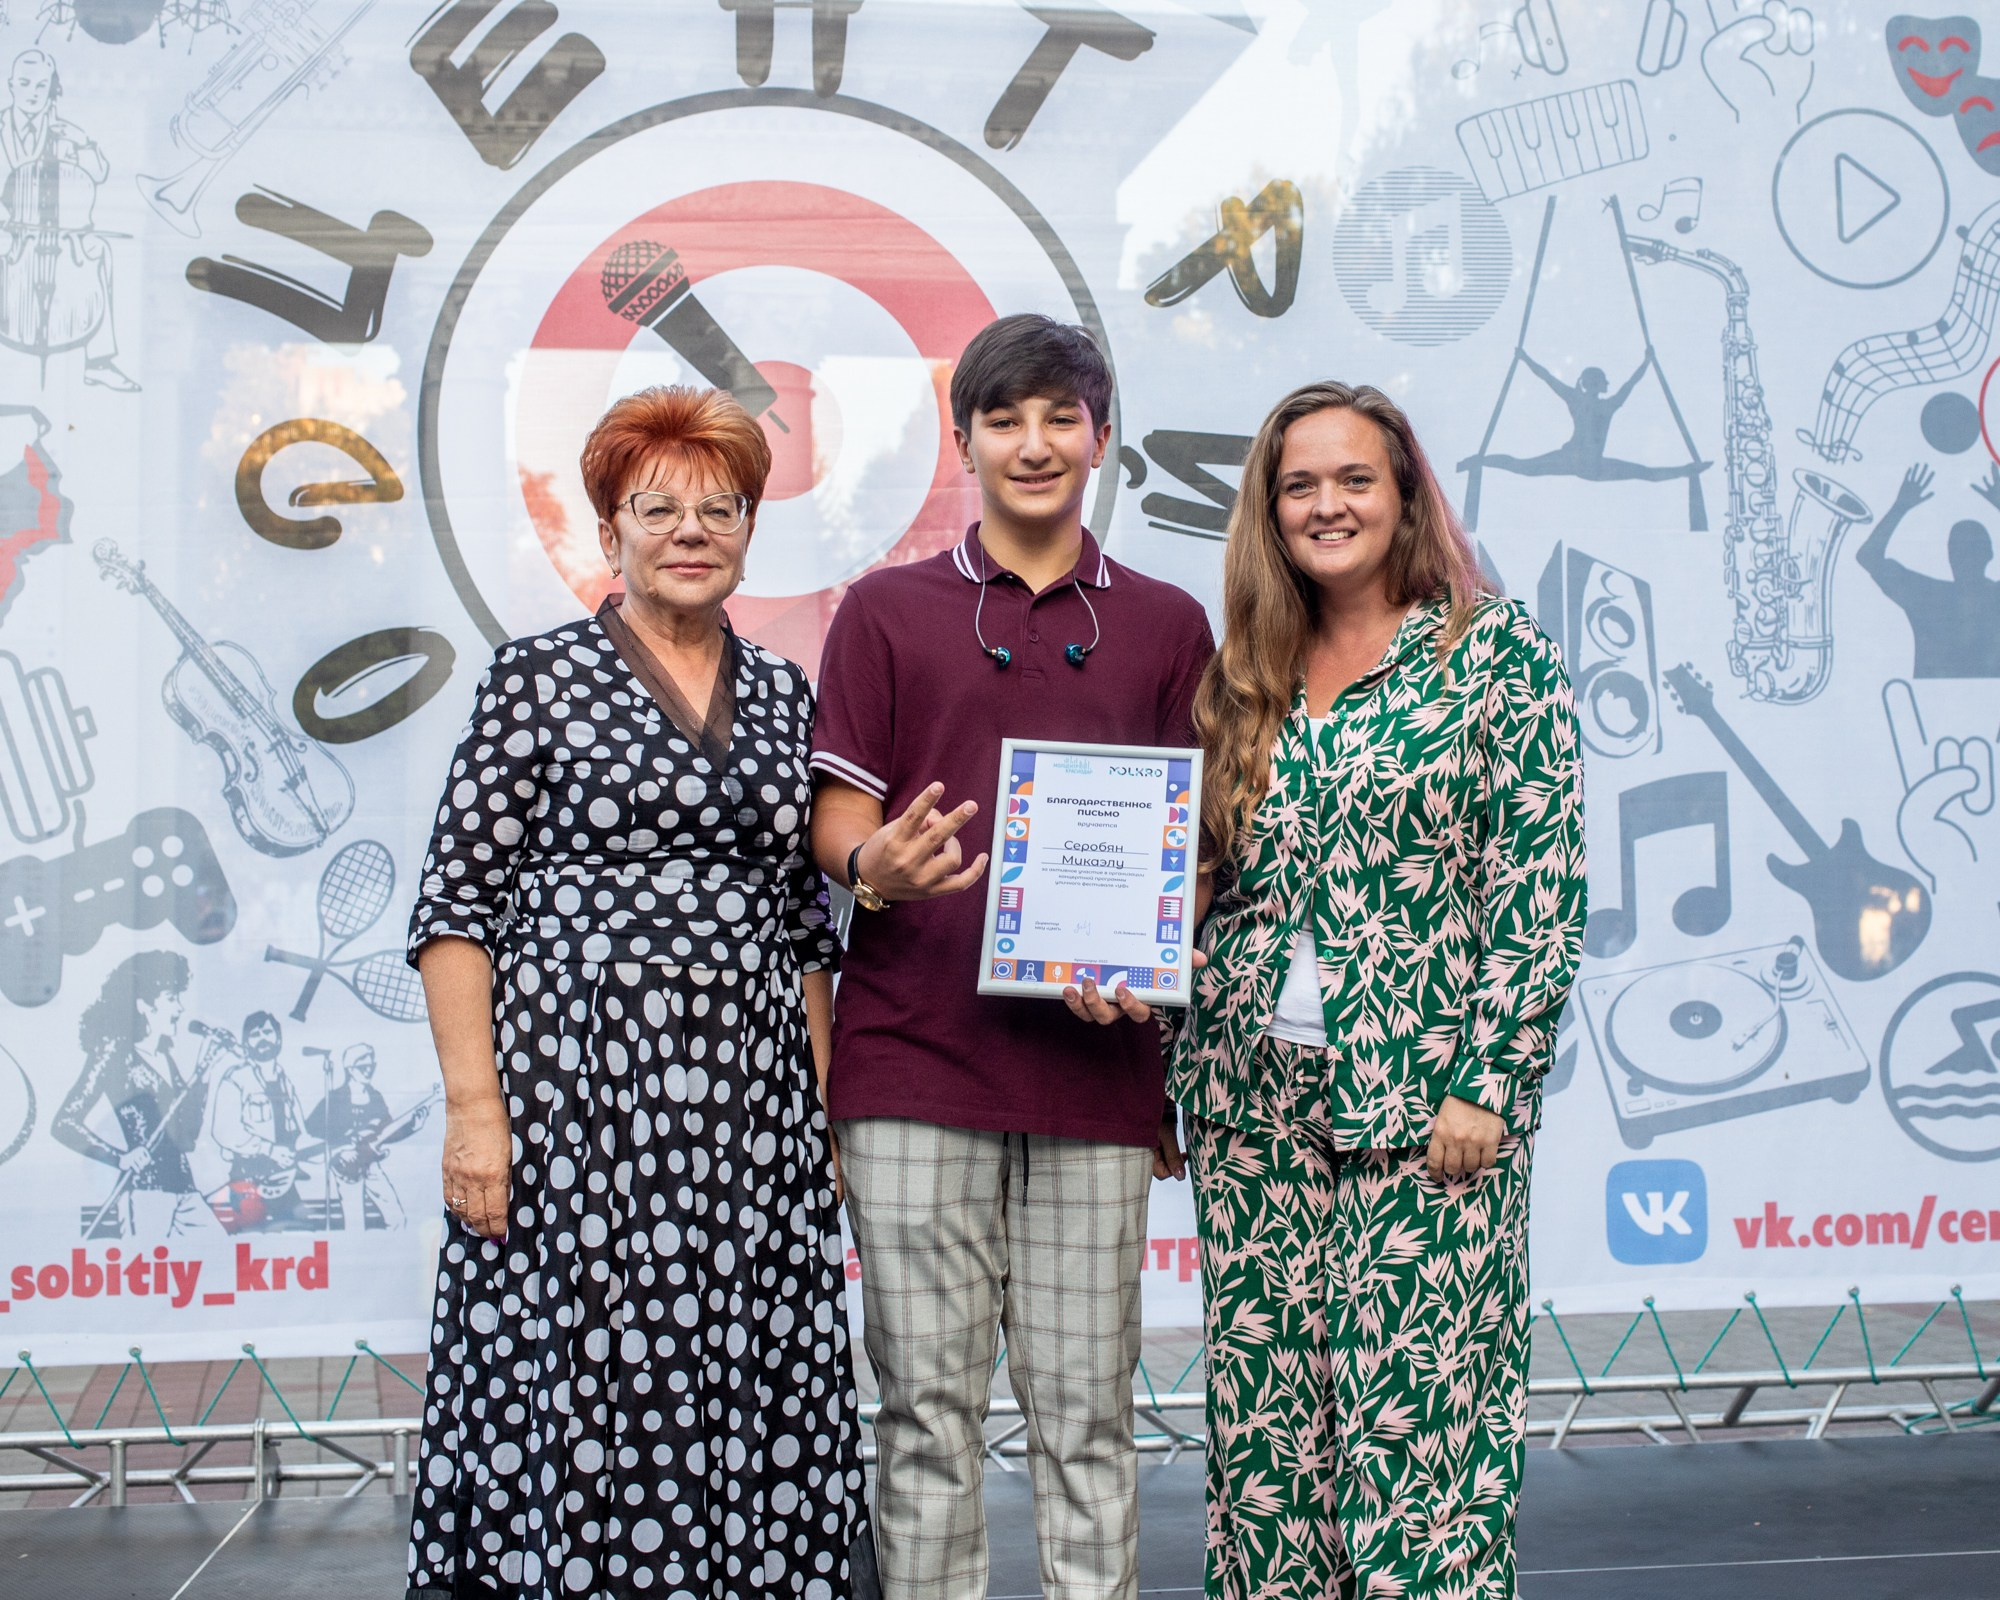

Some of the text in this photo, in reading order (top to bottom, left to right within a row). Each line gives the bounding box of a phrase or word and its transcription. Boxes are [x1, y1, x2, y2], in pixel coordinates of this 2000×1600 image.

[1046, 797, 1153, 809] БЛАГОДАРСТВЕННОЕ
[1077, 809, 1120, 818] ПИСЬМО
[1077, 821, 1118, 829] вручается
[1064, 840, 1124, 853] Серобян
[1062, 855, 1124, 869] Микаэлу
